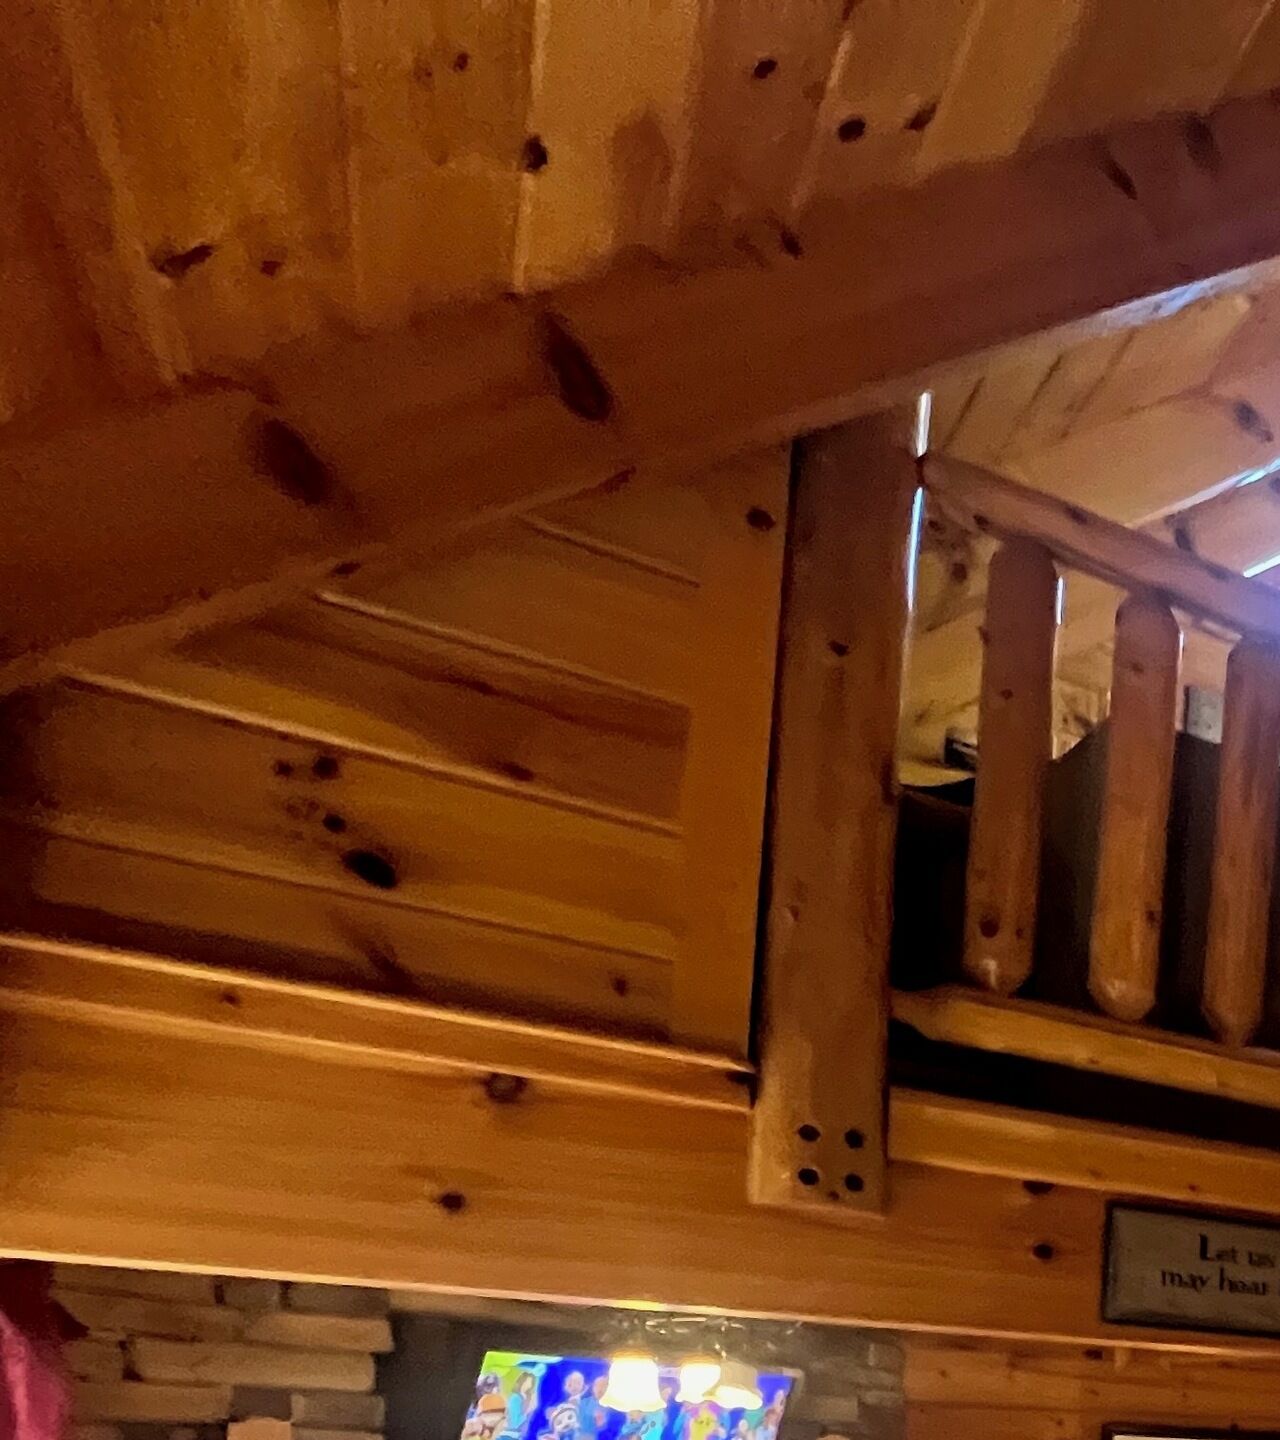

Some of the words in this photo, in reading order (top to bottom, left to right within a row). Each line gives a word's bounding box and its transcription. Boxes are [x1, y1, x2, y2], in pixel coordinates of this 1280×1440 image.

[1198, 1233, 1239, 1264] Let
[1160, 1269, 1210, 1293] may
[1218, 1266, 1269, 1297] hear
